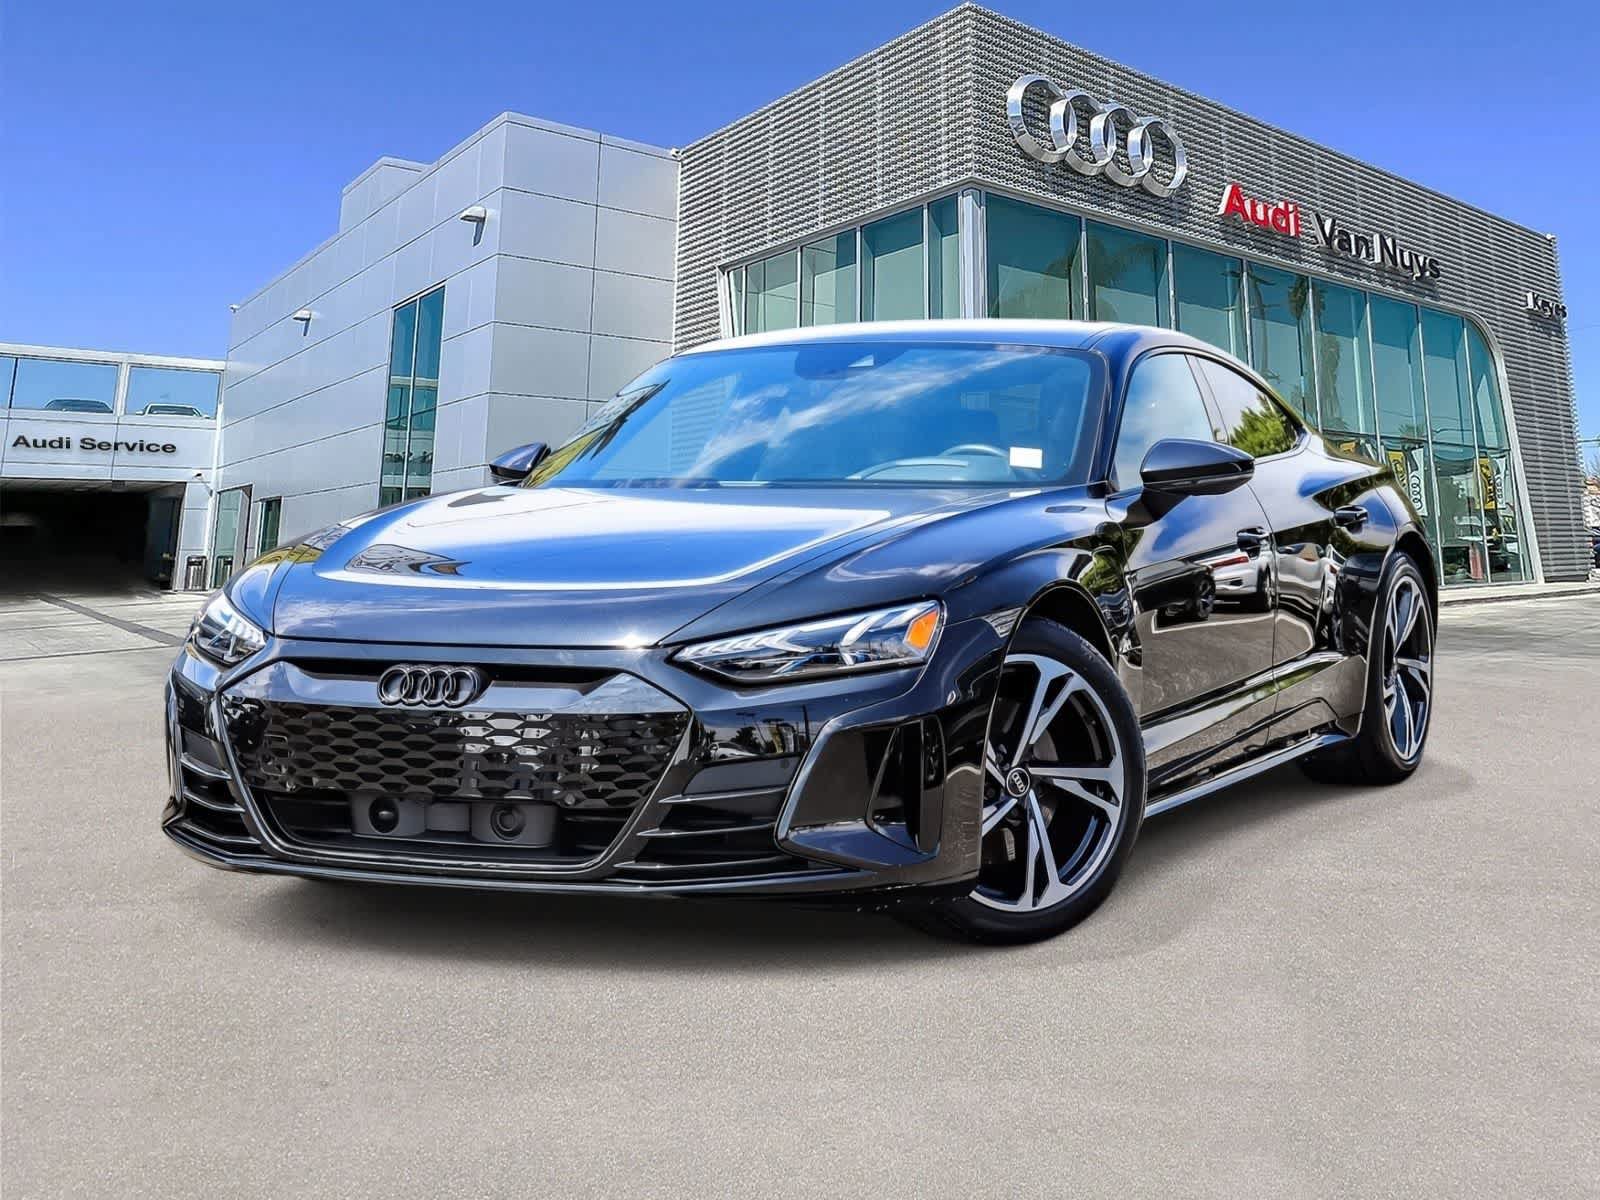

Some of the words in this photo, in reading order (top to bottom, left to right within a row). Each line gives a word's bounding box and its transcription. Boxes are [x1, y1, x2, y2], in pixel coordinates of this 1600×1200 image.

[1218, 182, 1302, 238] Audi
[1311, 212, 1375, 262] Van
[1373, 233, 1442, 280] Nuys
[1527, 291, 1568, 318] Keyes
[12, 435, 71, 449] Audi
[79, 437, 177, 453] Service
